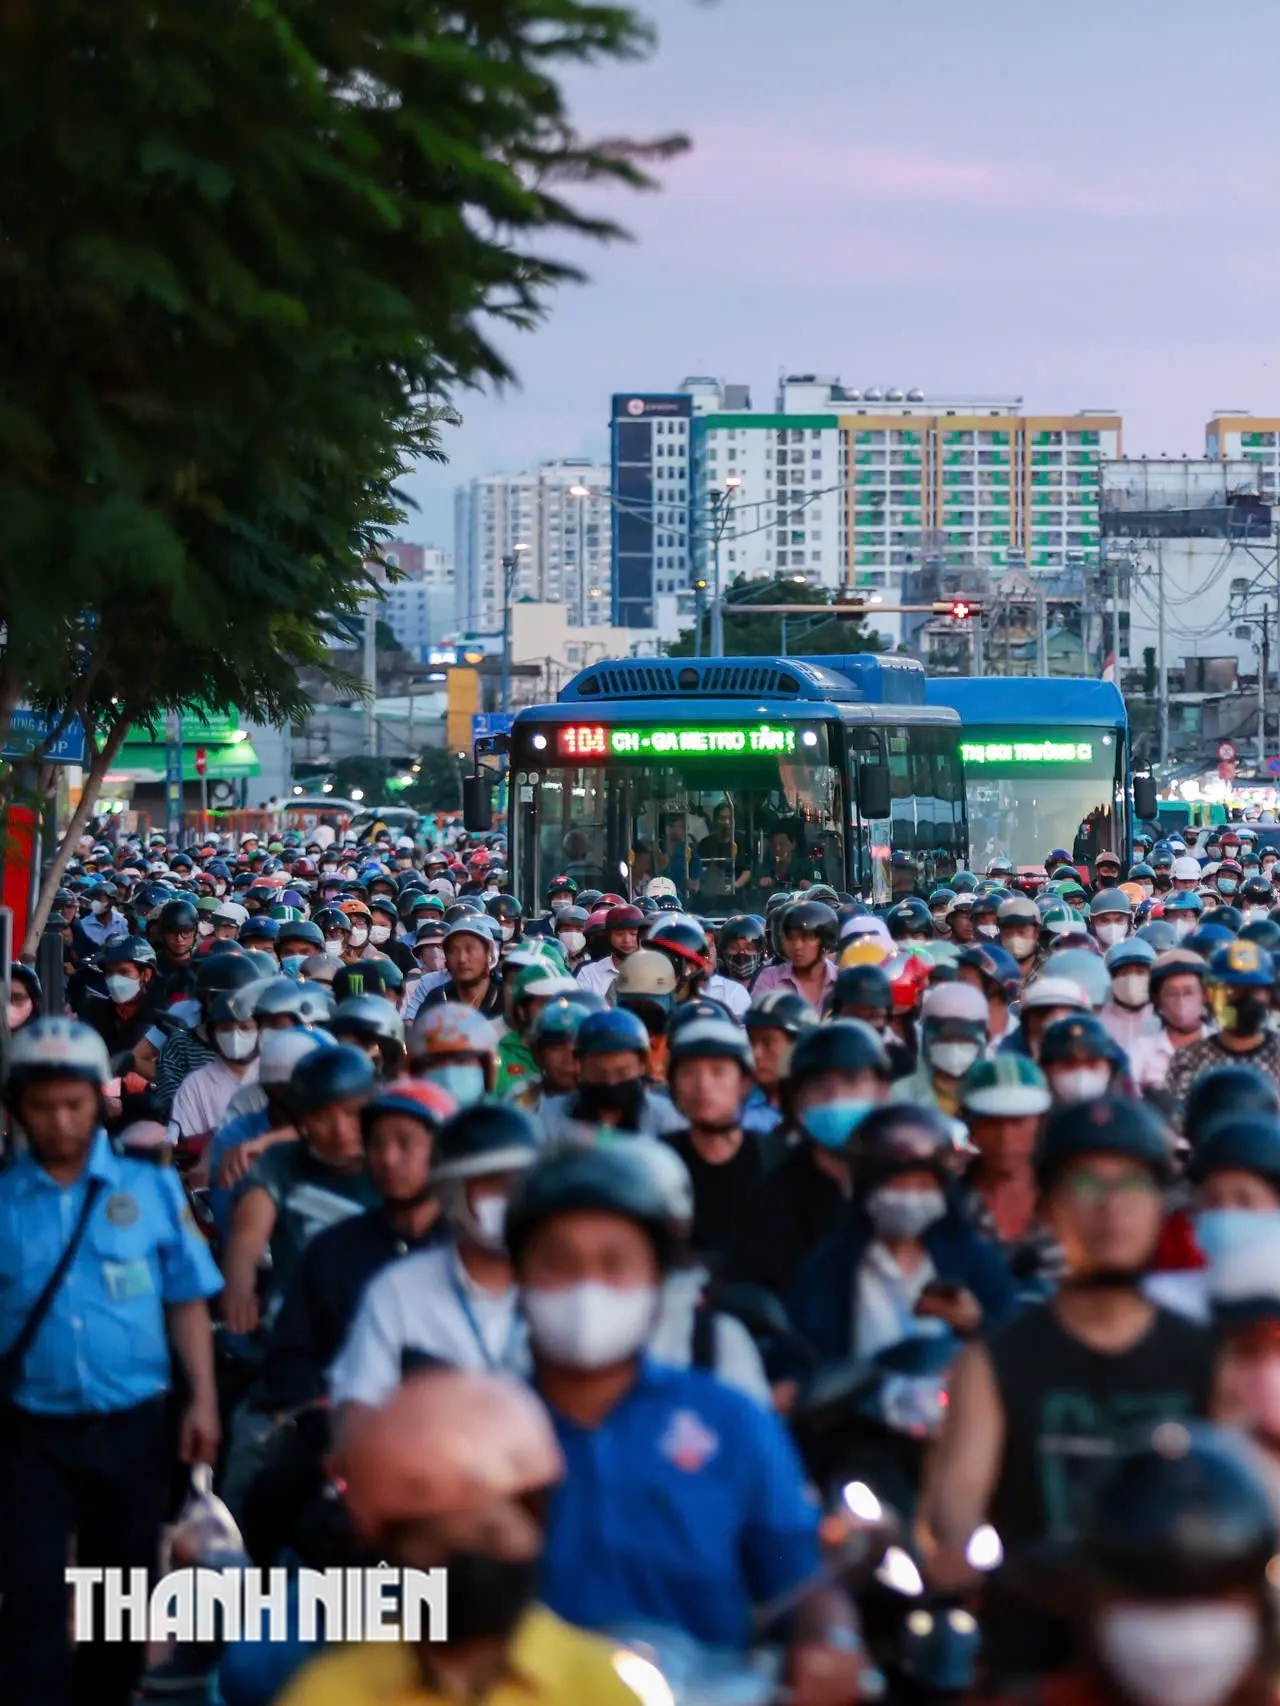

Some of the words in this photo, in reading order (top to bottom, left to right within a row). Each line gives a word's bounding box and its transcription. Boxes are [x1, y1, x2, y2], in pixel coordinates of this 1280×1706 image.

[564, 727, 606, 753] 104
[679, 732, 746, 752] METRO
[750, 725, 785, 750] TÂN
